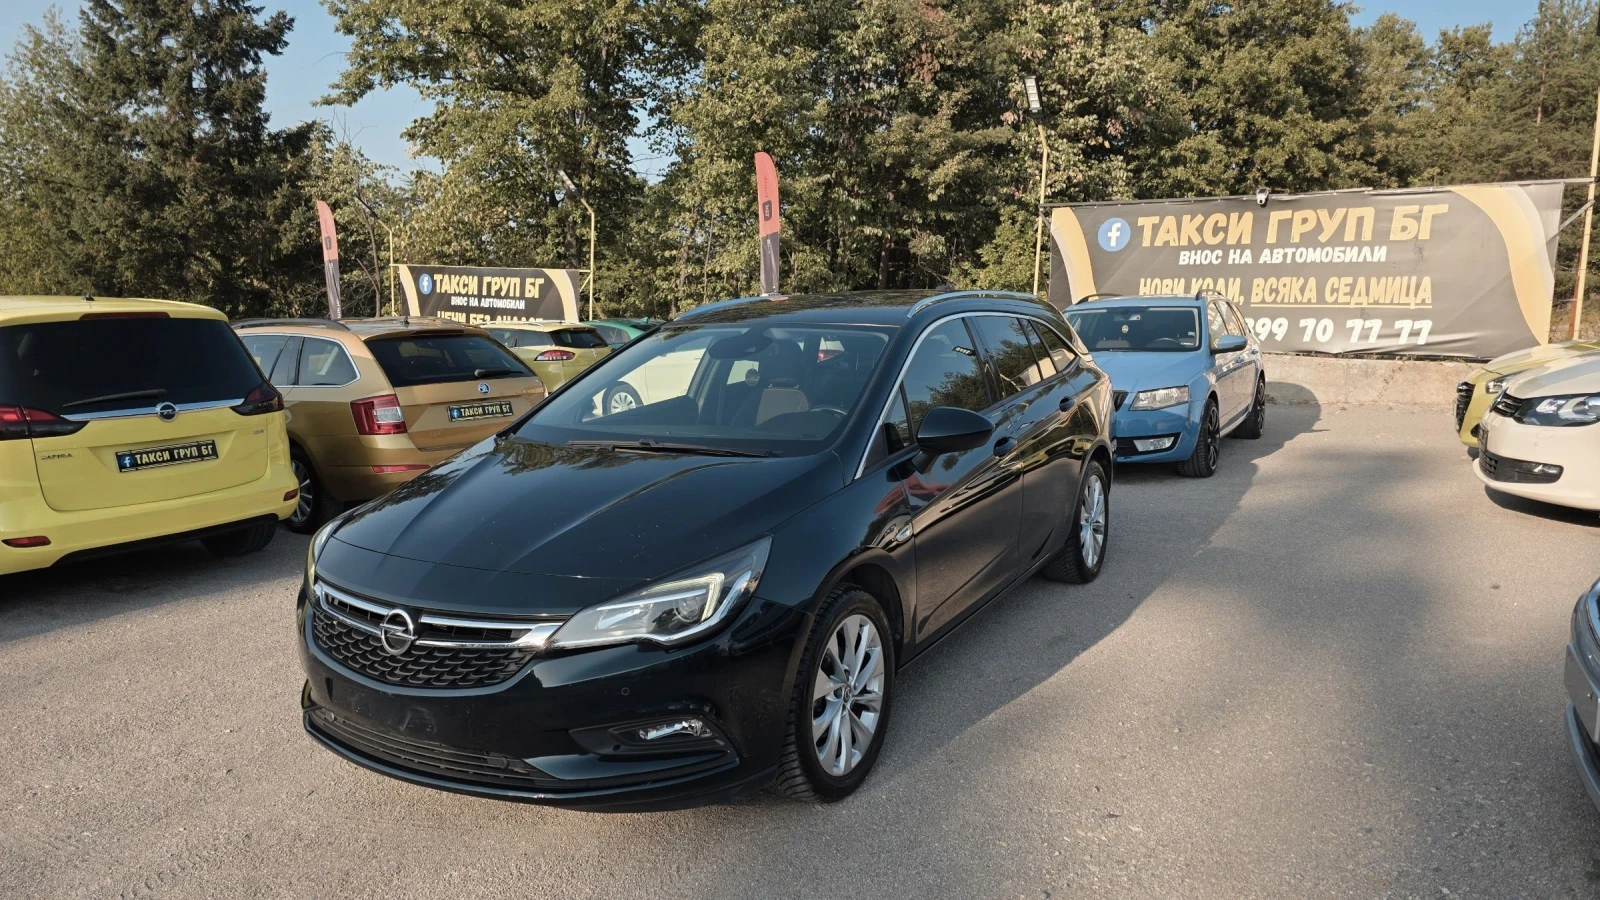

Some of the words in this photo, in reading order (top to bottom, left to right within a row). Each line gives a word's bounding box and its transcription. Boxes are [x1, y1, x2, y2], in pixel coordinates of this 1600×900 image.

[1137, 211, 1254, 247] ТАКСИ
[1266, 206, 1376, 244] ГРУП
[1389, 204, 1449, 241] БГ
[1178, 249, 1223, 265] ВНОС
[1227, 248, 1253, 265] НА
[1258, 245, 1388, 264] АВТОМОБИЛИ
[433, 274, 478, 295] ТАКСИ
[482, 276, 521, 298] ГРУП
[524, 278, 545, 299] БГ
[1250, 277, 1317, 304] ВСЯКА
[1325, 276, 1432, 309] СЕДМИЦА
[451, 296, 468, 306] ВНОС
[469, 297, 479, 307] НА
[480, 298, 526, 310] АВТОМОБИЛИ
[1299, 318, 1334, 343] 70
[1346, 318, 1383, 344] 77
[1394, 319, 1433, 345] 77
[460, 407, 484, 417] ТАКСИ
[485, 405, 501, 414] ГРУП
[135, 450, 171, 465] ТАКСИ
[173, 446, 199, 459] ГРУП
[201, 445, 213, 456] БГ
